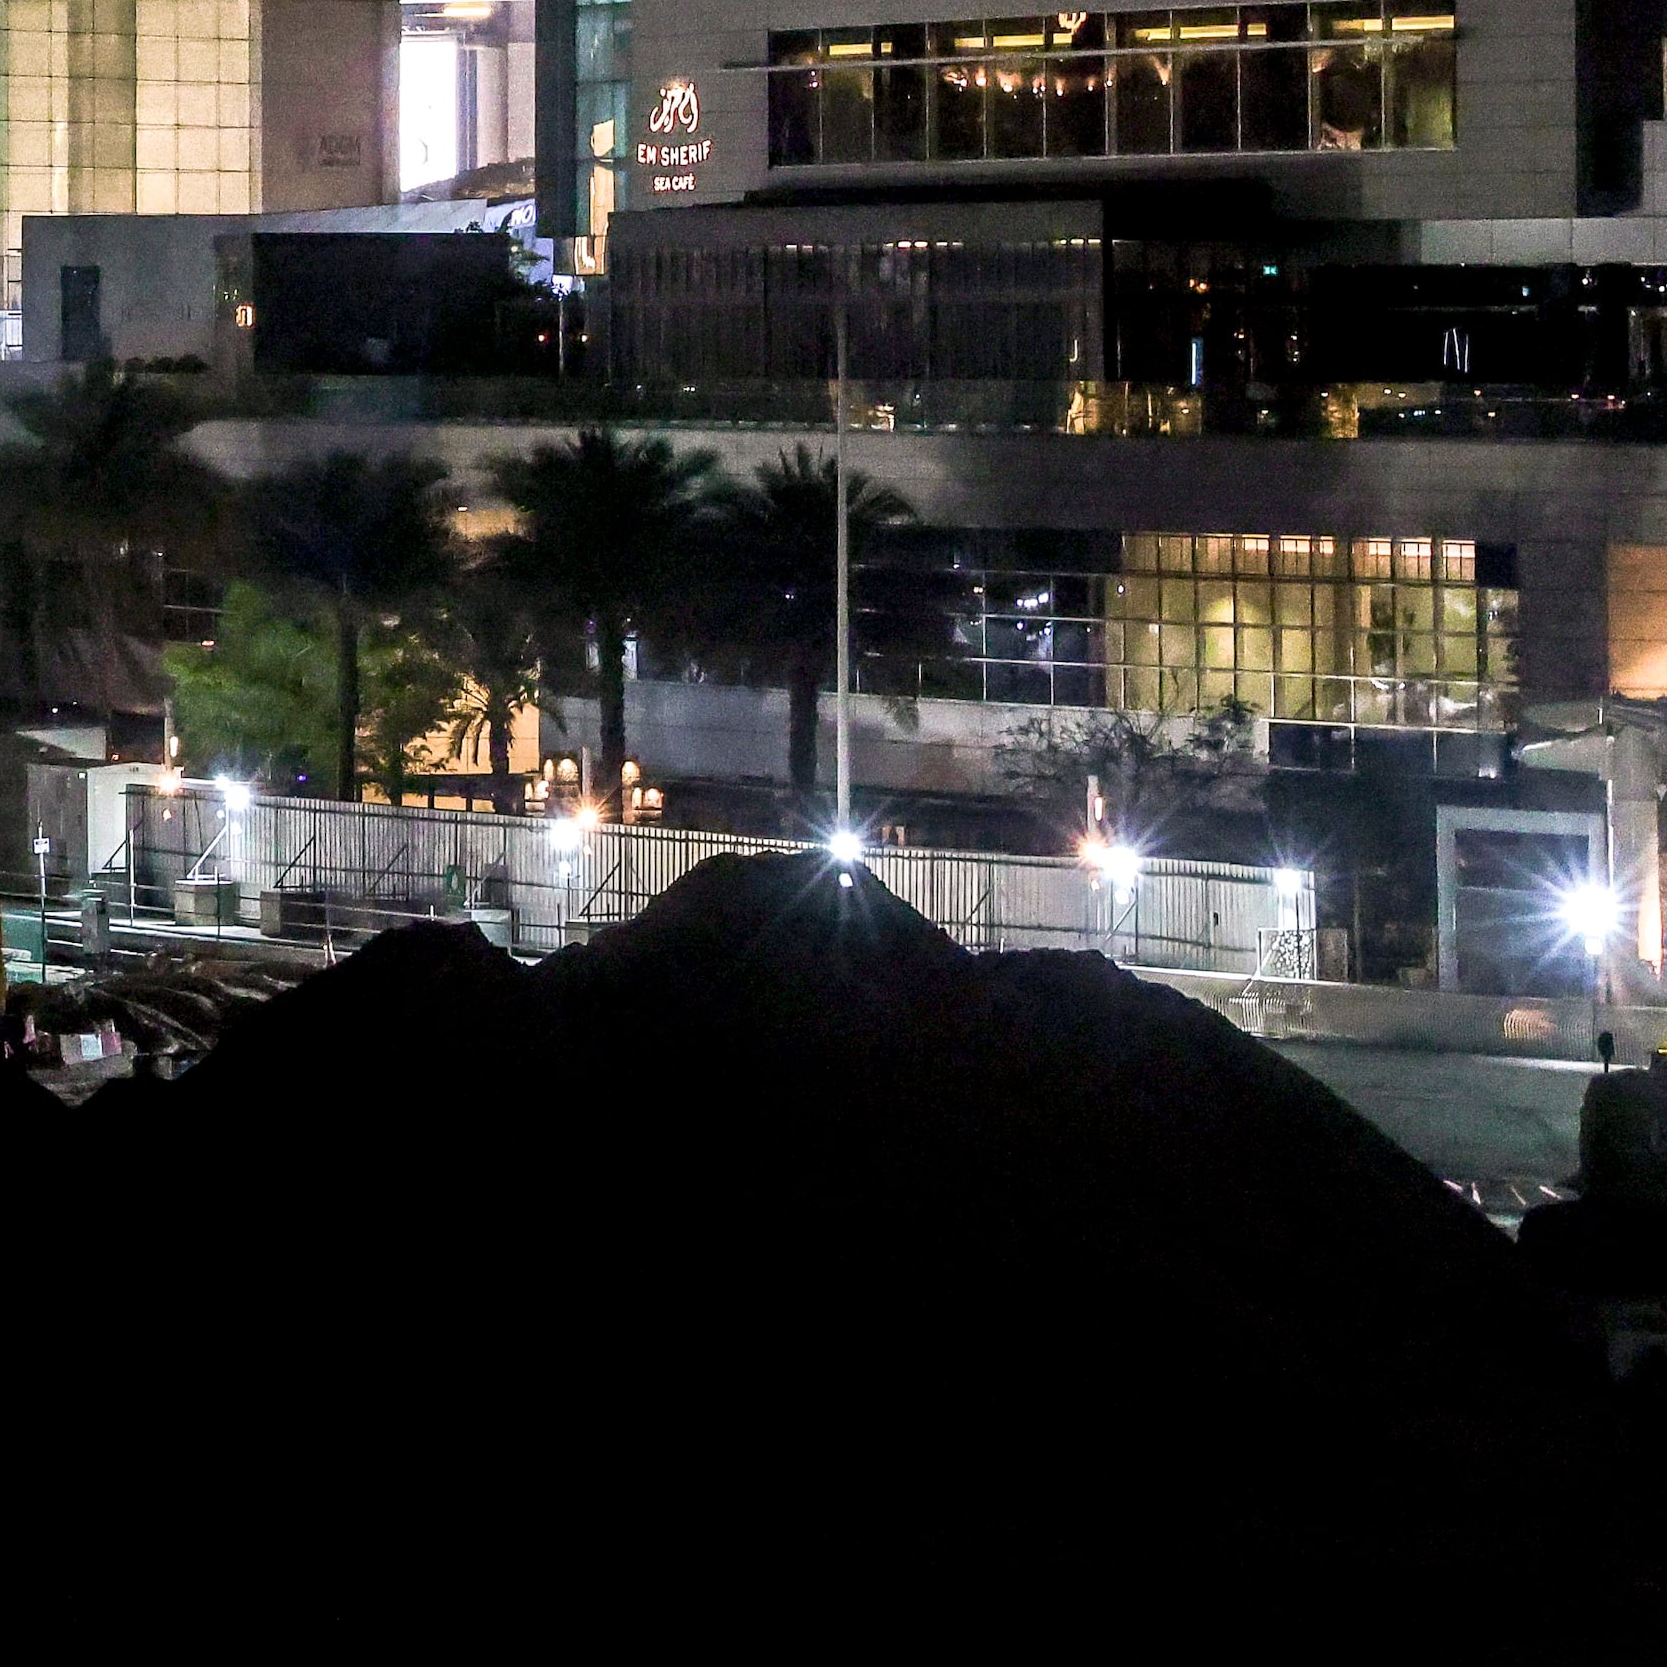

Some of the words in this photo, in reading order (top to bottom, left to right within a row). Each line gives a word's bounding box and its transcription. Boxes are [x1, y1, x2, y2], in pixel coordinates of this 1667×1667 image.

[637, 142, 657, 165] EM
[660, 139, 712, 167] SHERIF
[653, 176, 671, 191] SEA
